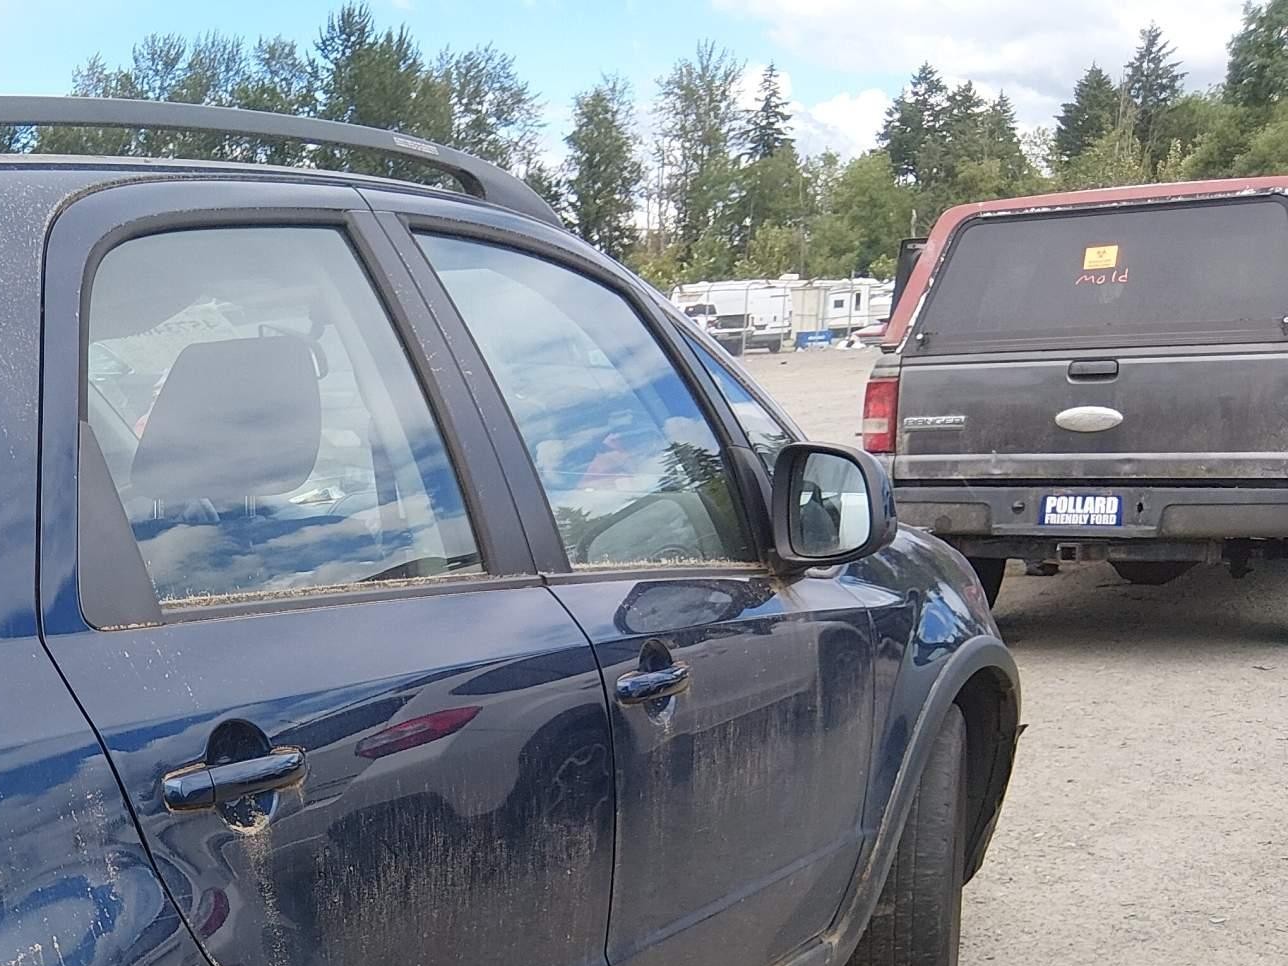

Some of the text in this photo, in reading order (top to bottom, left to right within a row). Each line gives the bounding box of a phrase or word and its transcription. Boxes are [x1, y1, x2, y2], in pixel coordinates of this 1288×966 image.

[1045, 496, 1119, 514] POLLARD
[1044, 513, 1117, 525] FRIENDLY FORD
